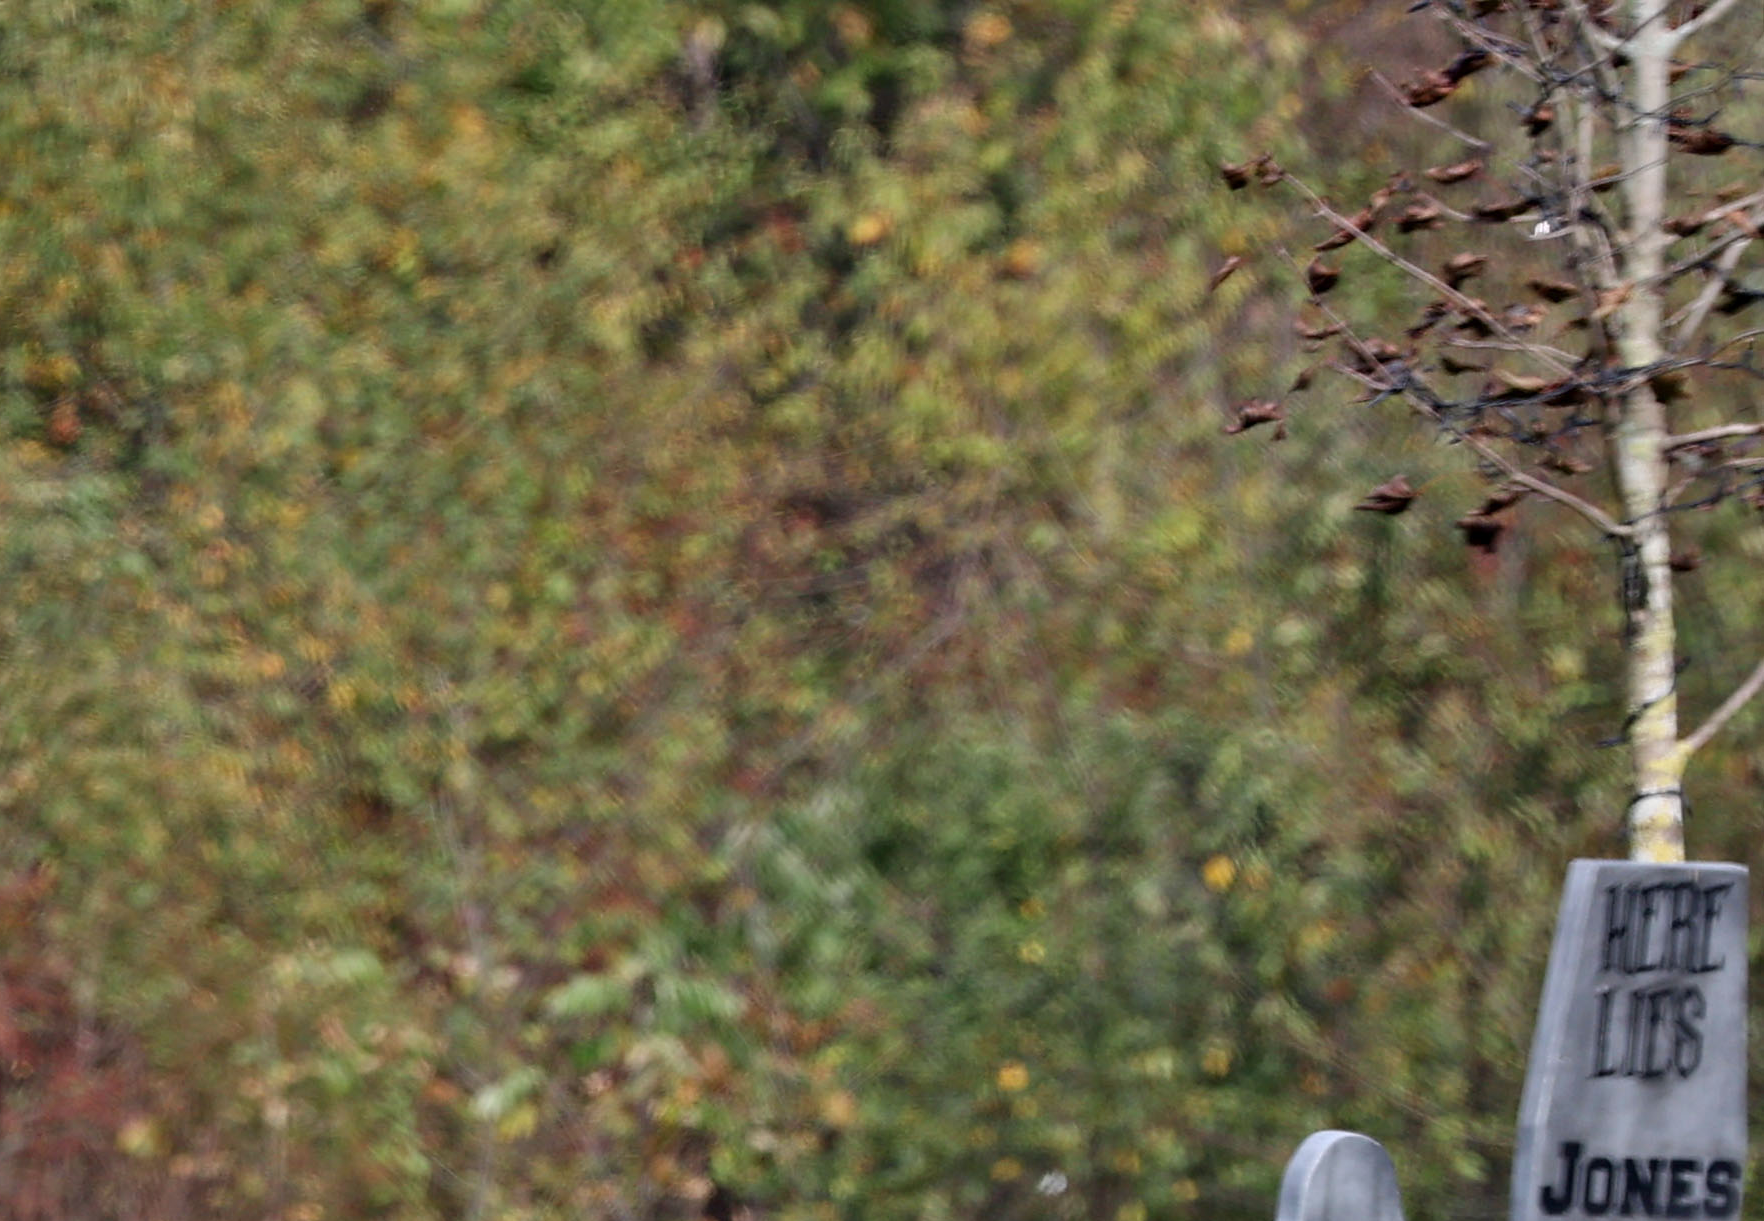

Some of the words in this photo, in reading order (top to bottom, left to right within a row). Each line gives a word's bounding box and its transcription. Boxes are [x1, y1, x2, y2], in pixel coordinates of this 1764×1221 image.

[1597, 881, 1735, 974] HERE
[1587, 986, 1706, 1080] LIES
[1540, 1142, 1743, 1218] JONES
